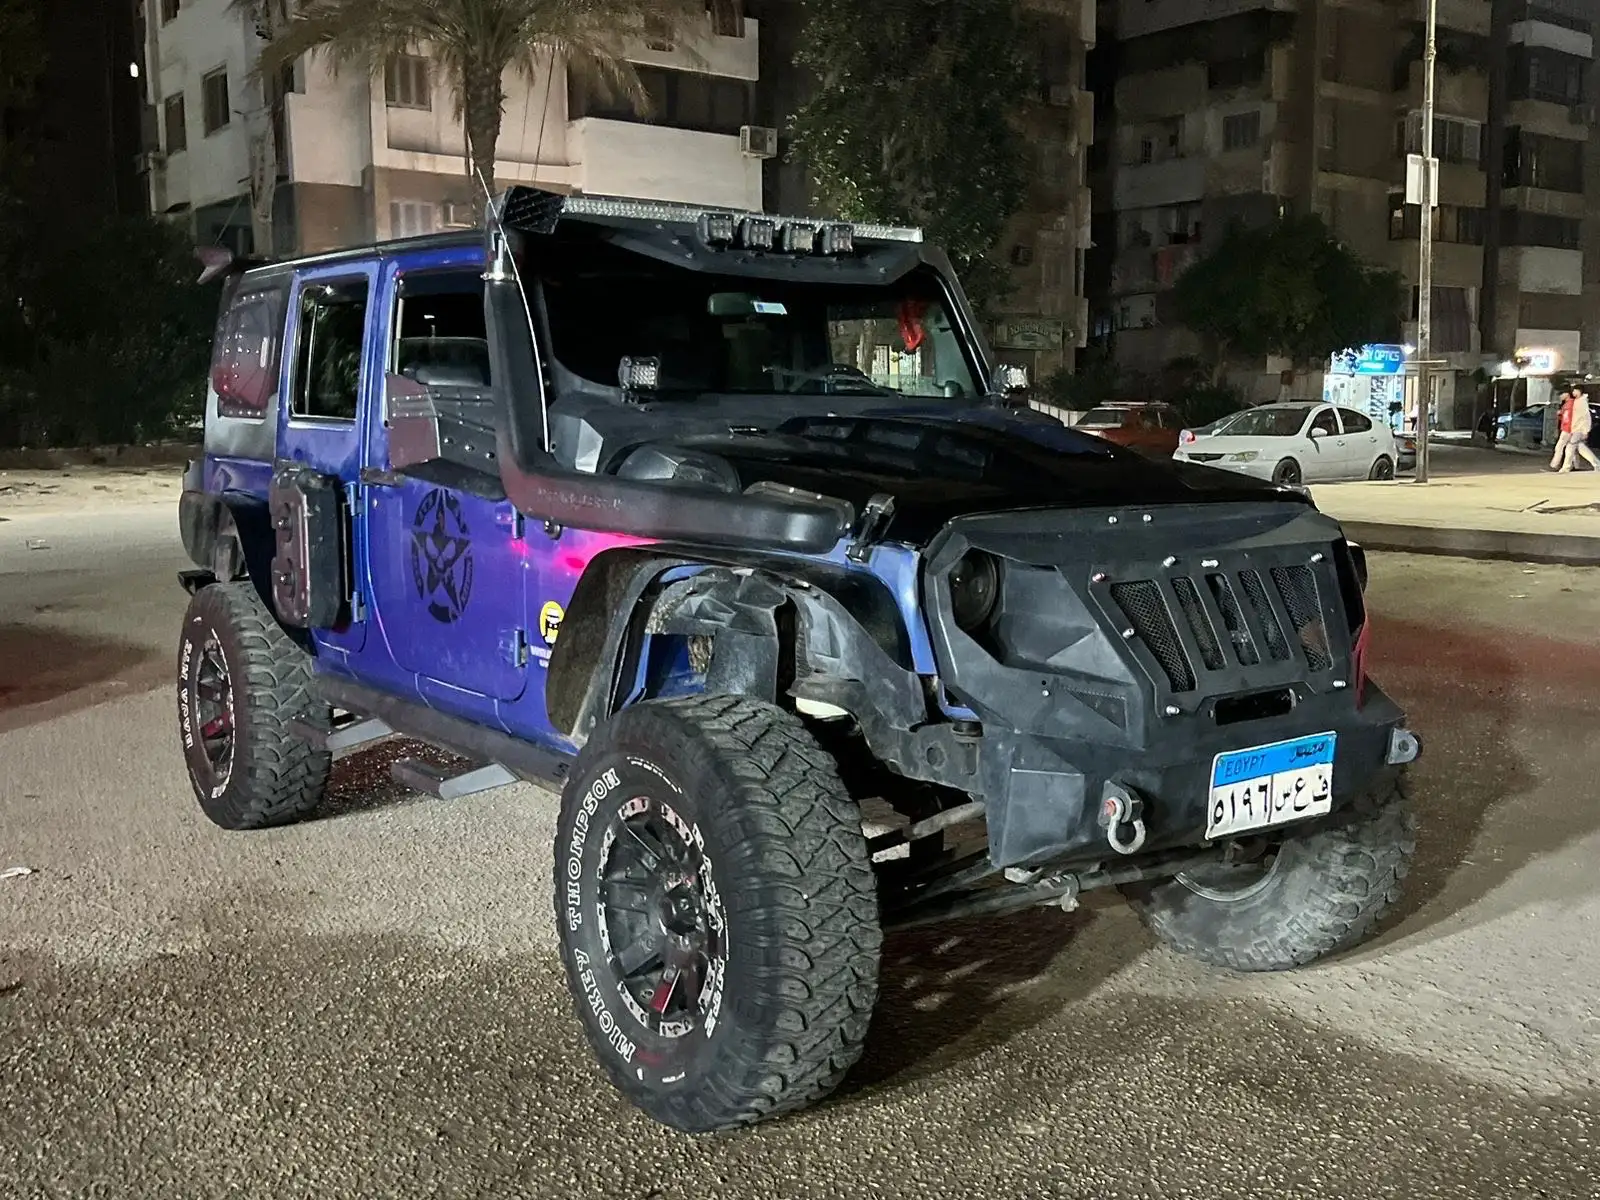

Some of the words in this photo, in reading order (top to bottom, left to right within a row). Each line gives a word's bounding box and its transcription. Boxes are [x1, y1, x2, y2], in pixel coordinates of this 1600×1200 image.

[1374, 349, 1400, 361] OPTICS
[1224, 754, 1267, 778] EGYPT
[567, 767, 621, 932] THOMPSON
[574, 947, 636, 1064] MICKEY
